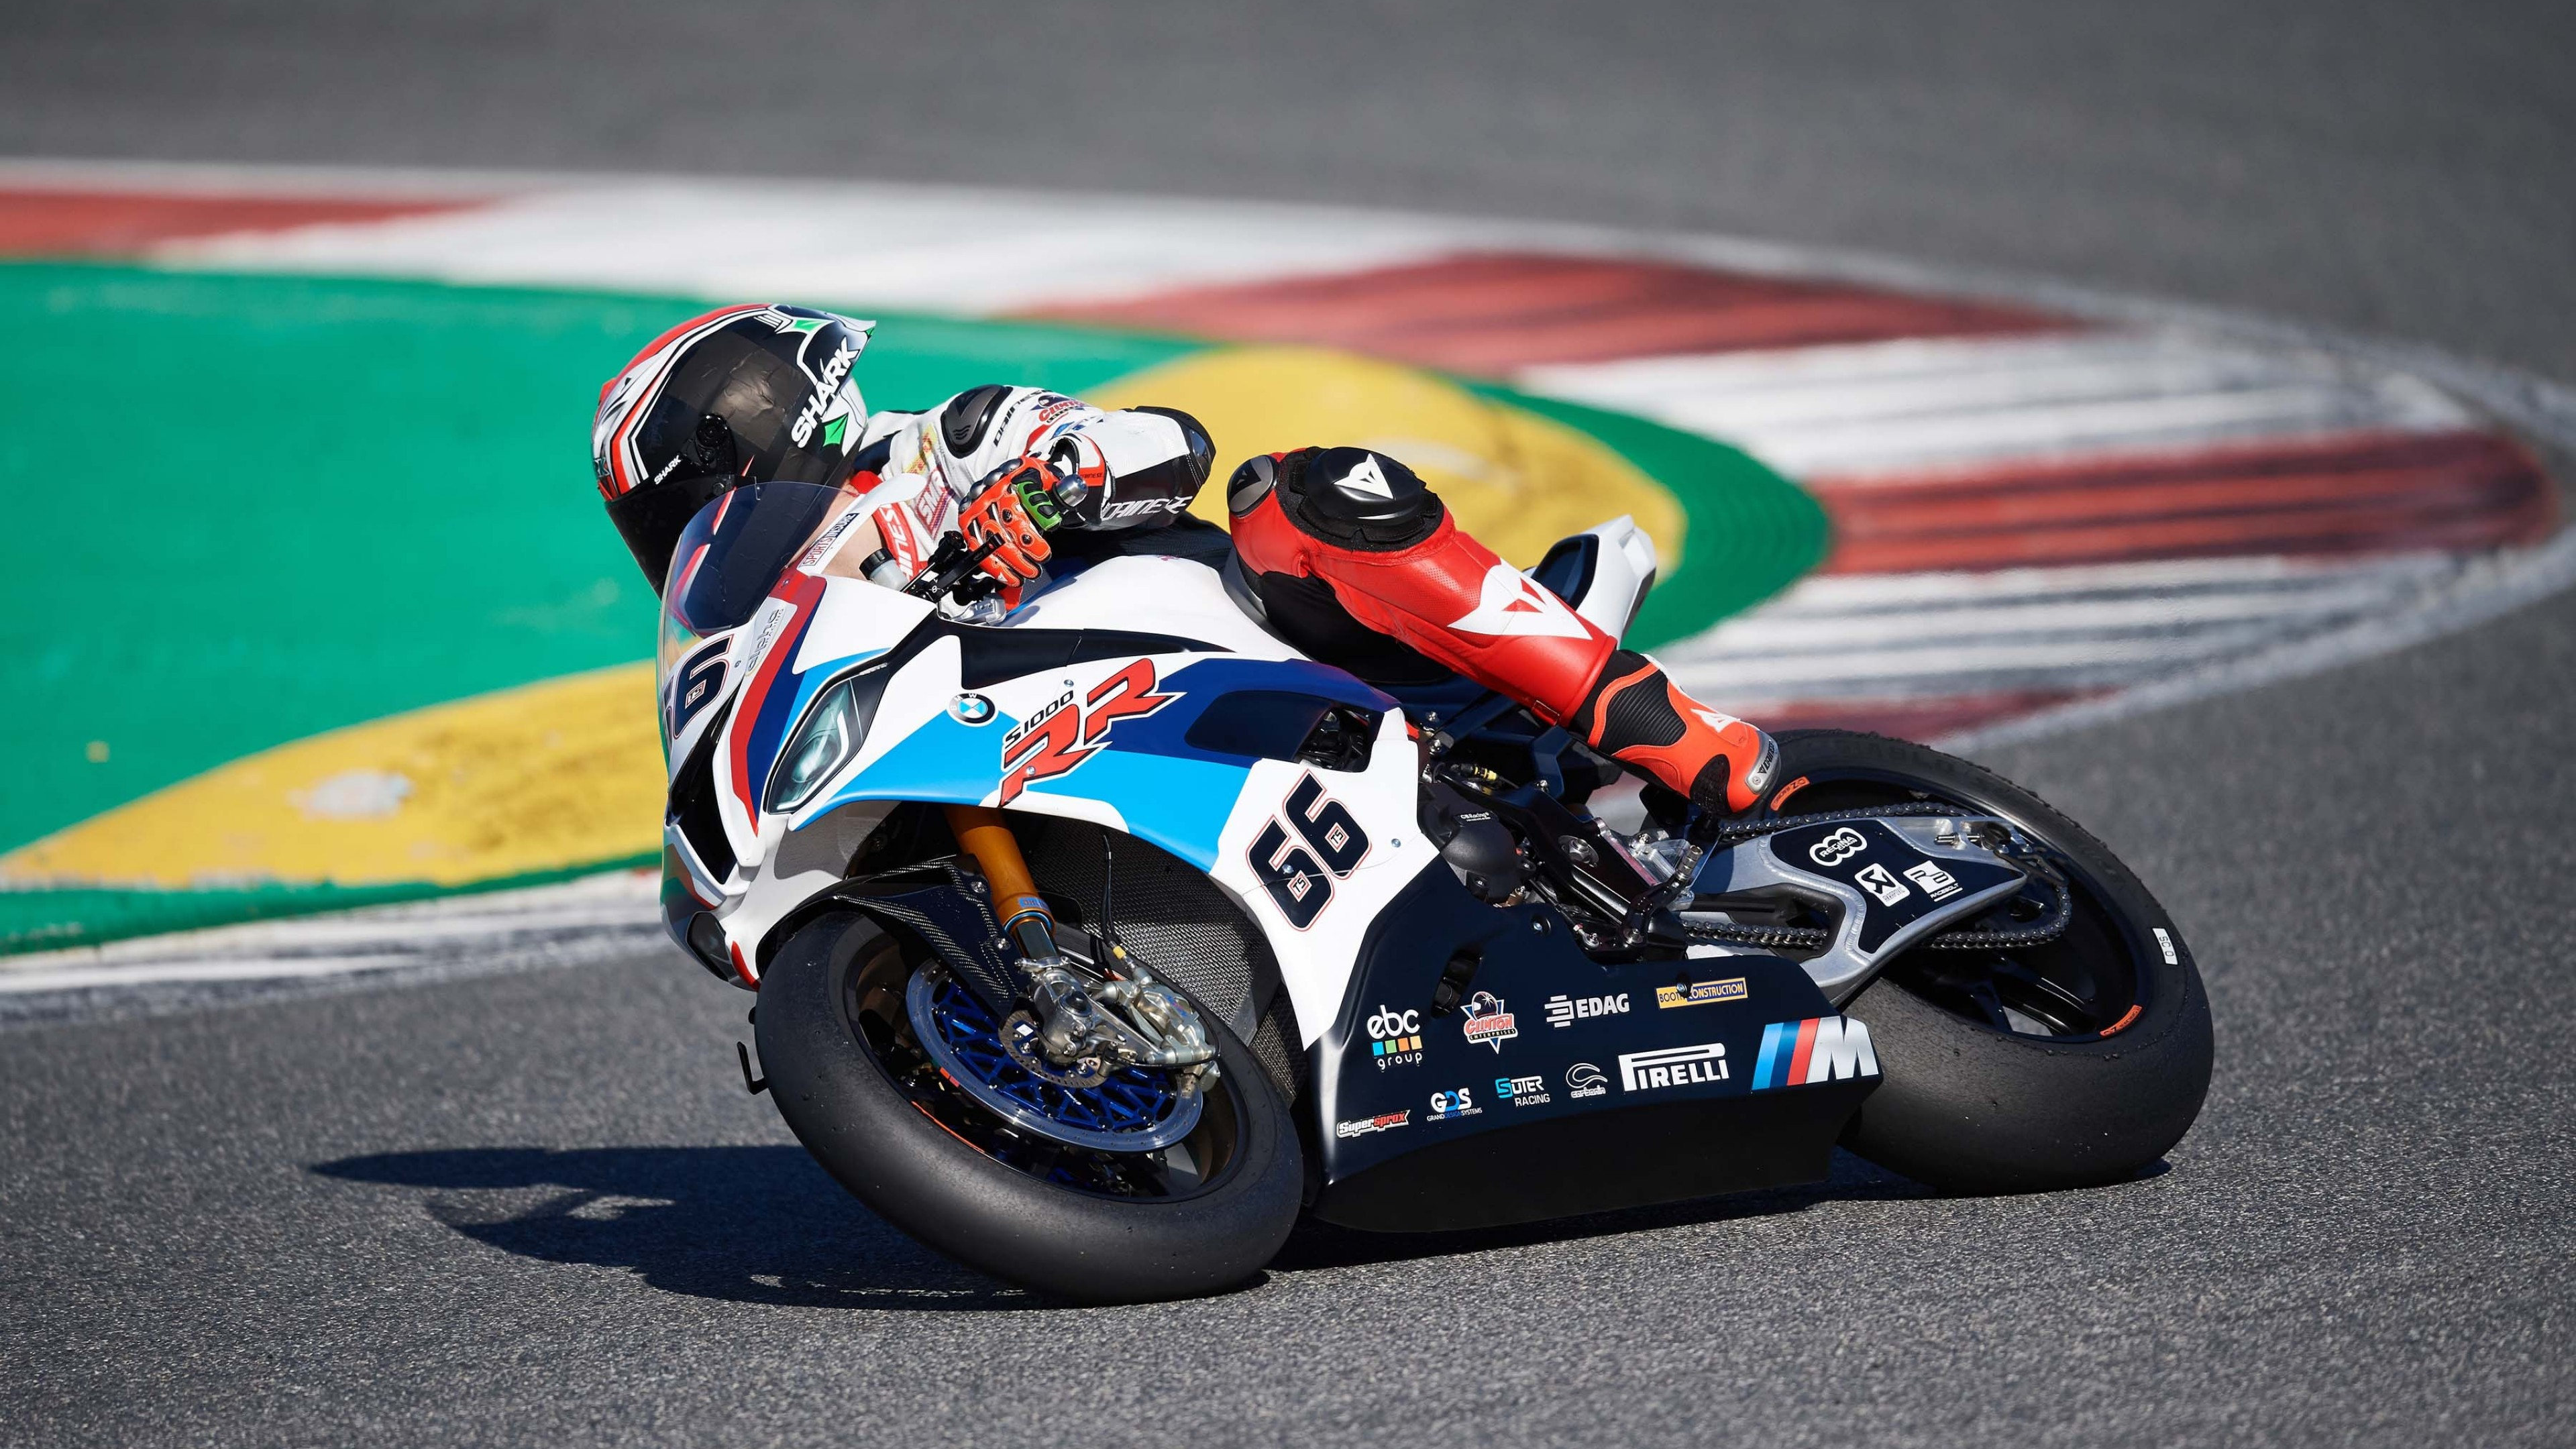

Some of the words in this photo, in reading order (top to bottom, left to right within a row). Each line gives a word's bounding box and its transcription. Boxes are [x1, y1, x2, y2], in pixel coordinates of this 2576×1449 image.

[792, 335, 860, 448] SHARK
[654, 455, 682, 484] SHARK
[1006, 690, 1073, 743] S1000
[998, 657, 1175, 808] RR
[1246, 769, 1371, 931] 66
[1330, 830, 1344, 845] TS
[1819, 836, 1854, 857] REGINA
[1292, 877, 1306, 894] TS
[1576, 993, 1630, 1018] EDAG
[1367, 1005, 1420, 1039] ebc
[1466, 1014, 1513, 1034] CLINTON
[1470, 1029, 1516, 1040] ENTERPRISES
[1377, 1052, 1422, 1071] group
[1805, 1016, 1878, 1085] M
[1619, 1042, 1729, 1092] PIRELLI
[1430, 1087, 1472, 1113] GDS
[1514, 1093, 1550, 1107] RACING
[1339, 1112, 1405, 1135] Supersprox
